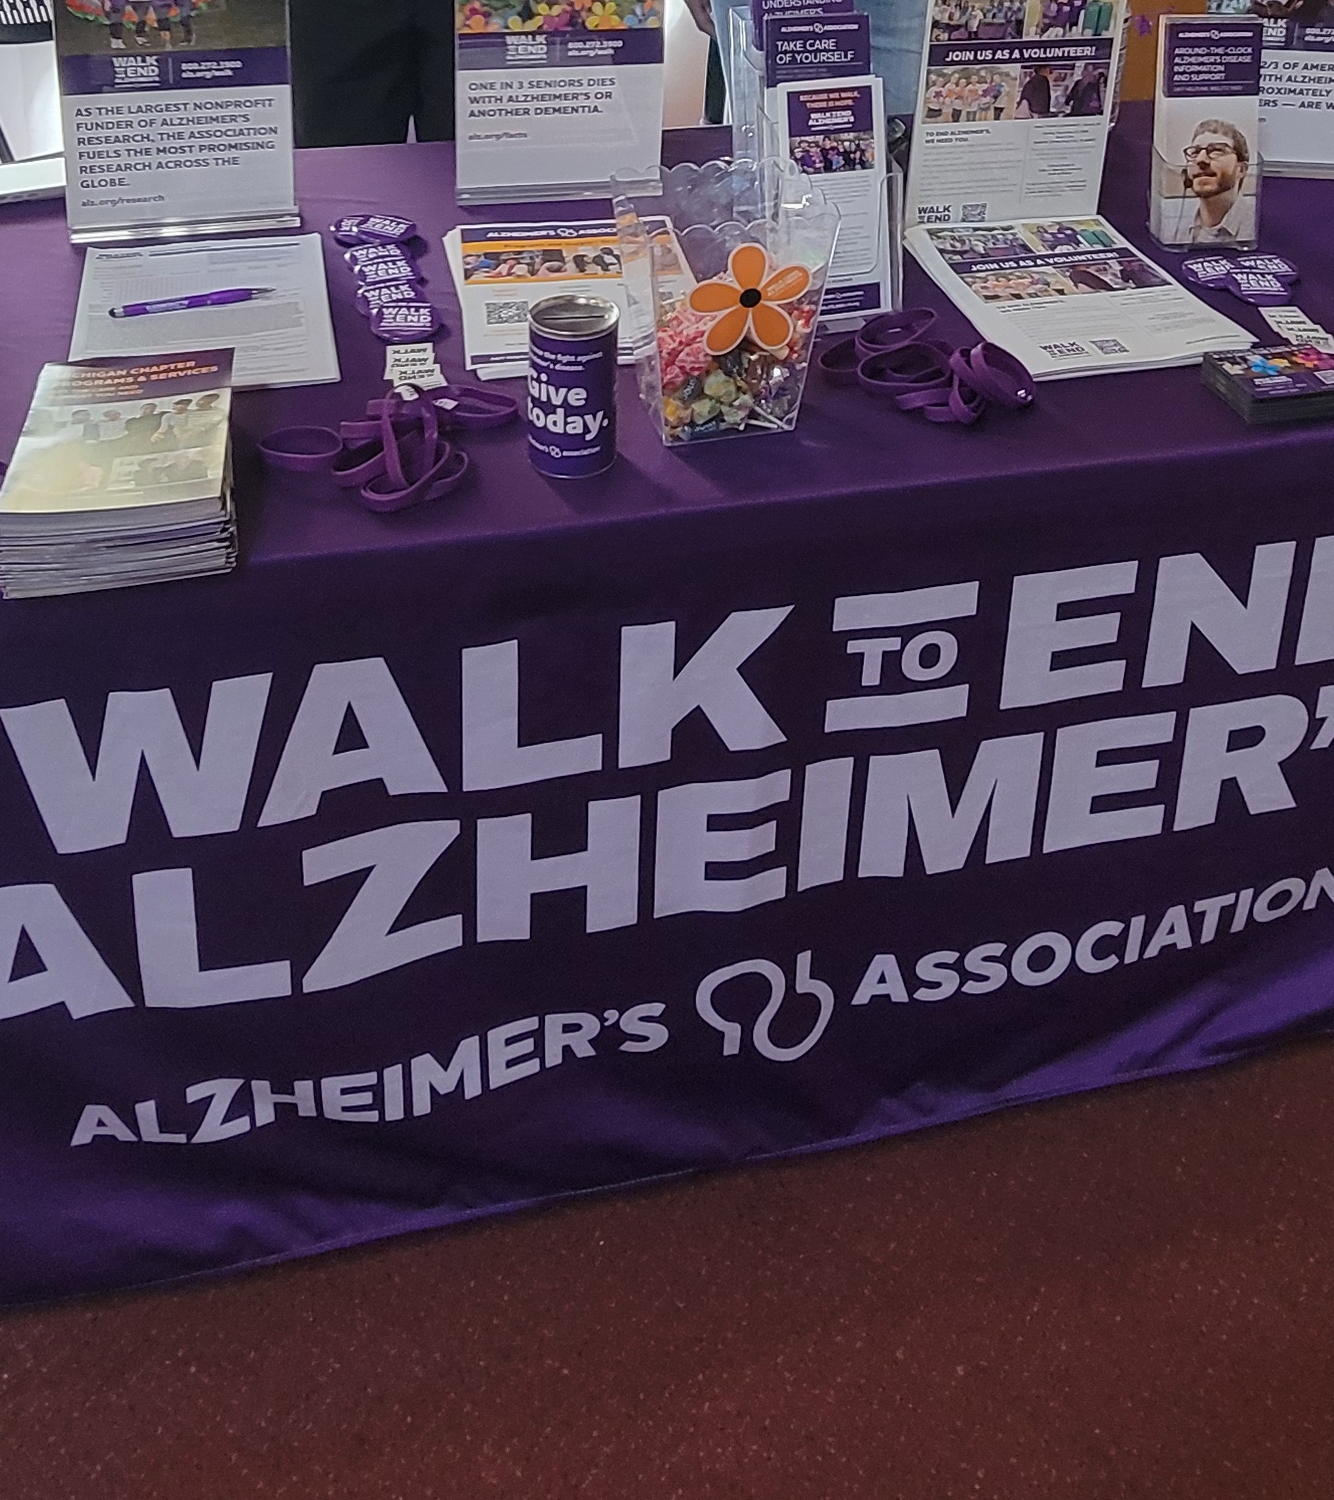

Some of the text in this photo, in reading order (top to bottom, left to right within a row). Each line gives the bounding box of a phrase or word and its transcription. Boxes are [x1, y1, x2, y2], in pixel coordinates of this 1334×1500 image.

[1262, 18, 1287, 28] ALK
[505, 35, 547, 45] WALK
[776, 39, 837, 51] TAKE CARE
[518, 45, 547, 54] END
[945, 46, 1096, 61] JOIN US AS A VOLUNTEER!
[112, 55, 159, 67] WALK
[776, 51, 855, 65] OF YOURSELF
[1221, 55, 1252, 63] DISEASE
[127, 66, 159, 77] END
[1173, 64, 1225, 72] INFORMATION
[1261, 61, 1279, 70] 2/3
[1282, 62, 1299, 71] OF
[1173, 72, 1225, 81] AND SUPPORT
[1260, 73, 1282, 83] ITH
[468, 77, 616, 91] ONE IN 3 SENIORS DIES
[468, 91, 613, 105] WITH ALZHEIMER'S OR
[1260, 87, 1332, 97] ROXIMATELY
[74, 98, 275, 117] AS THE LARGEST NONPROFIT
[1298, 100, 1321, 109] ARE
[468, 105, 603, 118] ANOTHER DEMENTIA.
[76, 113, 250, 132] FUNDER OF ALZHEIMER'S
[158, 131, 185, 141] THE
[188, 126, 278, 140] ASSOCIATION
[78, 141, 275, 160] FUELS THE MOST PROMISING
[79, 156, 240, 175] RESEARCH ACROSS THE
[80, 178, 130, 189] GLOBE.
[81, 195, 165, 208] alz.org/research
[918, 205, 952, 215] WALK
[927, 214, 951, 223] END
[353, 244, 396, 257] WALK
[362, 260, 408, 272] WALK
[970, 251, 1119, 271] JOIN US AS A VOLUNTEER!
[1241, 258, 1282, 267] WALK
[378, 266, 411, 277] END
[1232, 273, 1275, 282] WALK
[364, 284, 412, 297] WALK
[381, 292, 416, 302] END
[382, 308, 431, 316] WALK
[396, 315, 432, 323] END
[1040, 341, 1079, 351] WALK
[1056, 347, 1086, 356] END
[129, 361, 196, 375] CHAPTER
[149, 366, 219, 380] SERVICES
[528, 367, 587, 406] Give
[528, 396, 609, 440] today.
[846, 631, 957, 686] TO
[71, 1002, 669, 1146] ALZHEIMER'S
